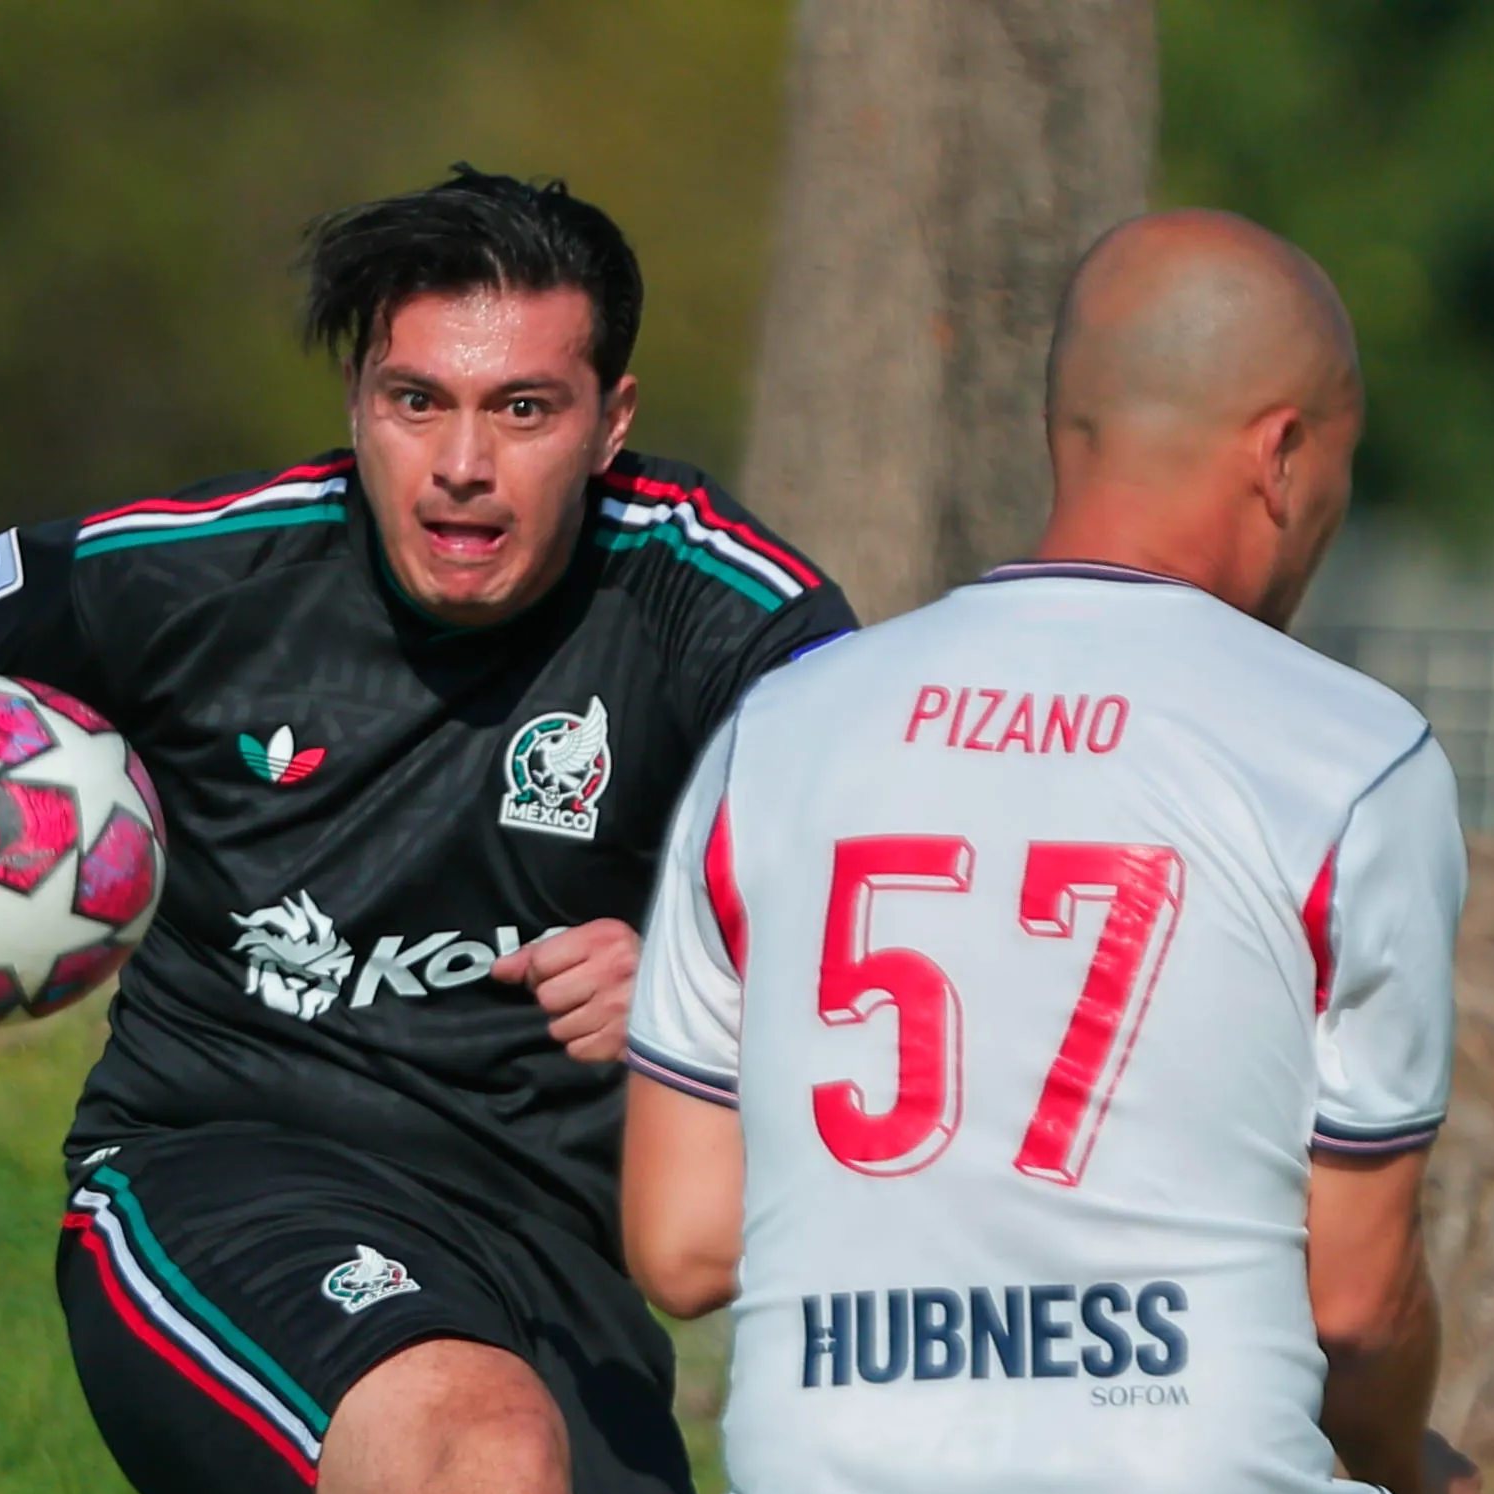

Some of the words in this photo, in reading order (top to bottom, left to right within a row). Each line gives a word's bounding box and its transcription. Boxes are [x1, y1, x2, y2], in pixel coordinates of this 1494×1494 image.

[903, 684, 1132, 755] PIZANO
[508, 801, 591, 831] MÉXICO
[811, 833, 1187, 1188] 57
[801, 1280, 1190, 1389] HUBNESS
[1090, 1384, 1191, 1407] SOFOM
